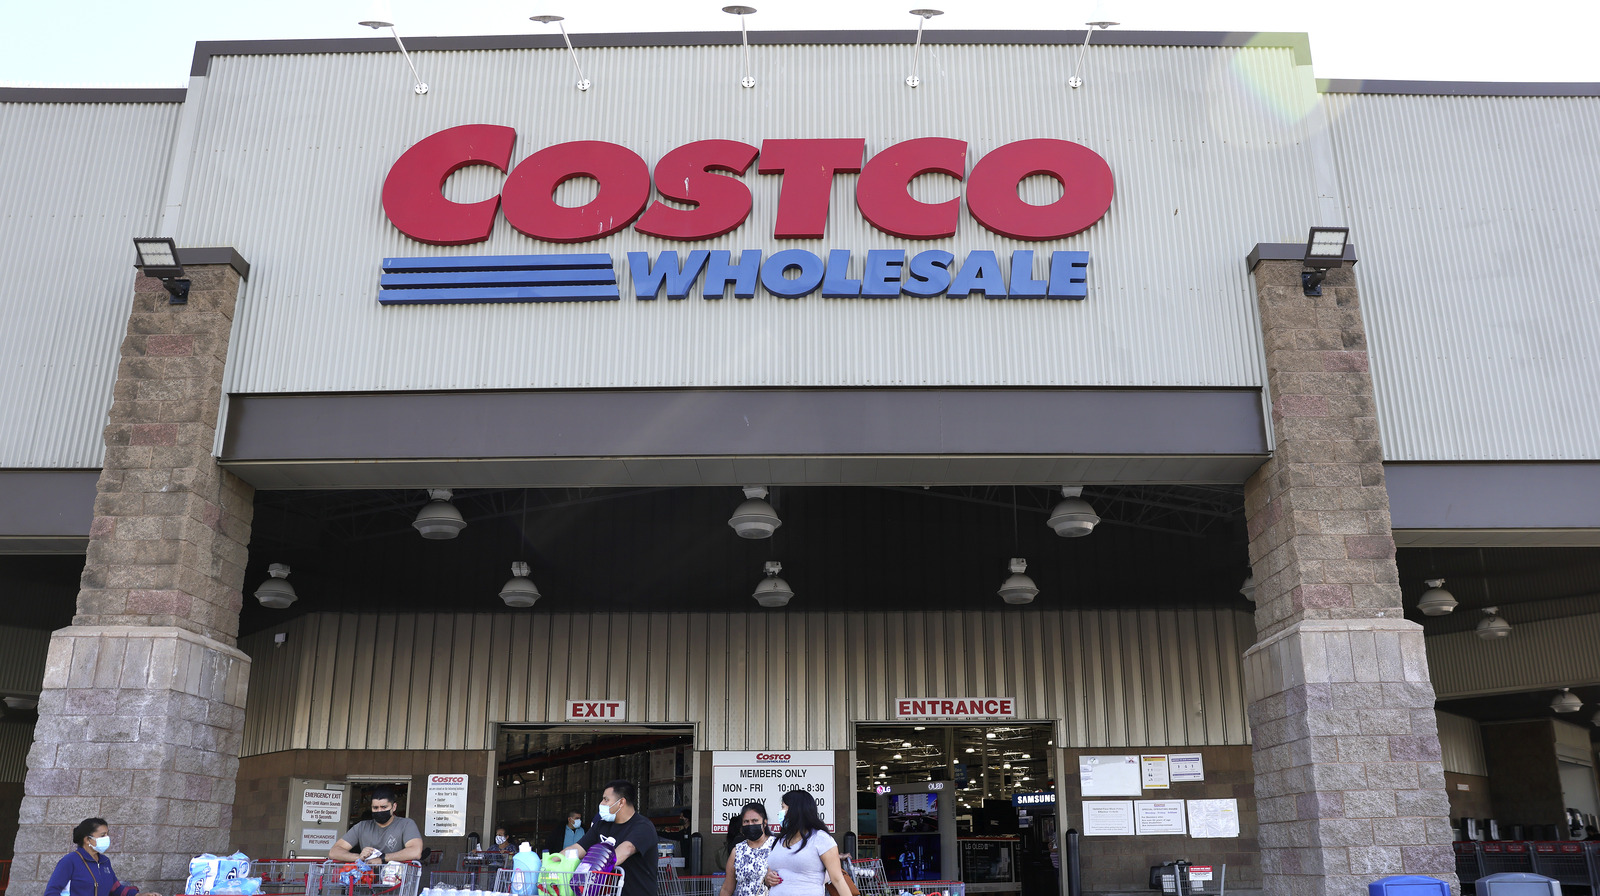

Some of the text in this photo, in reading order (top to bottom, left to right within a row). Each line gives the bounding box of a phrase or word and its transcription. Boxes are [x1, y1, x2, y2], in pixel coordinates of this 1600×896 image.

[382, 124, 1113, 245] COSTCO
[627, 248, 1089, 300] WHOLESALE
[572, 703, 619, 717] EXIT
[899, 700, 1012, 715] ENTRANCE
[740, 769, 807, 778] MEMBERS ONLY
[722, 784, 742, 792] MON
[749, 784, 763, 792] FRI
[777, 783, 800, 792] 10:00
[807, 783, 825, 792] 8:30
[1017, 794, 1056, 804] SAMSUNG
